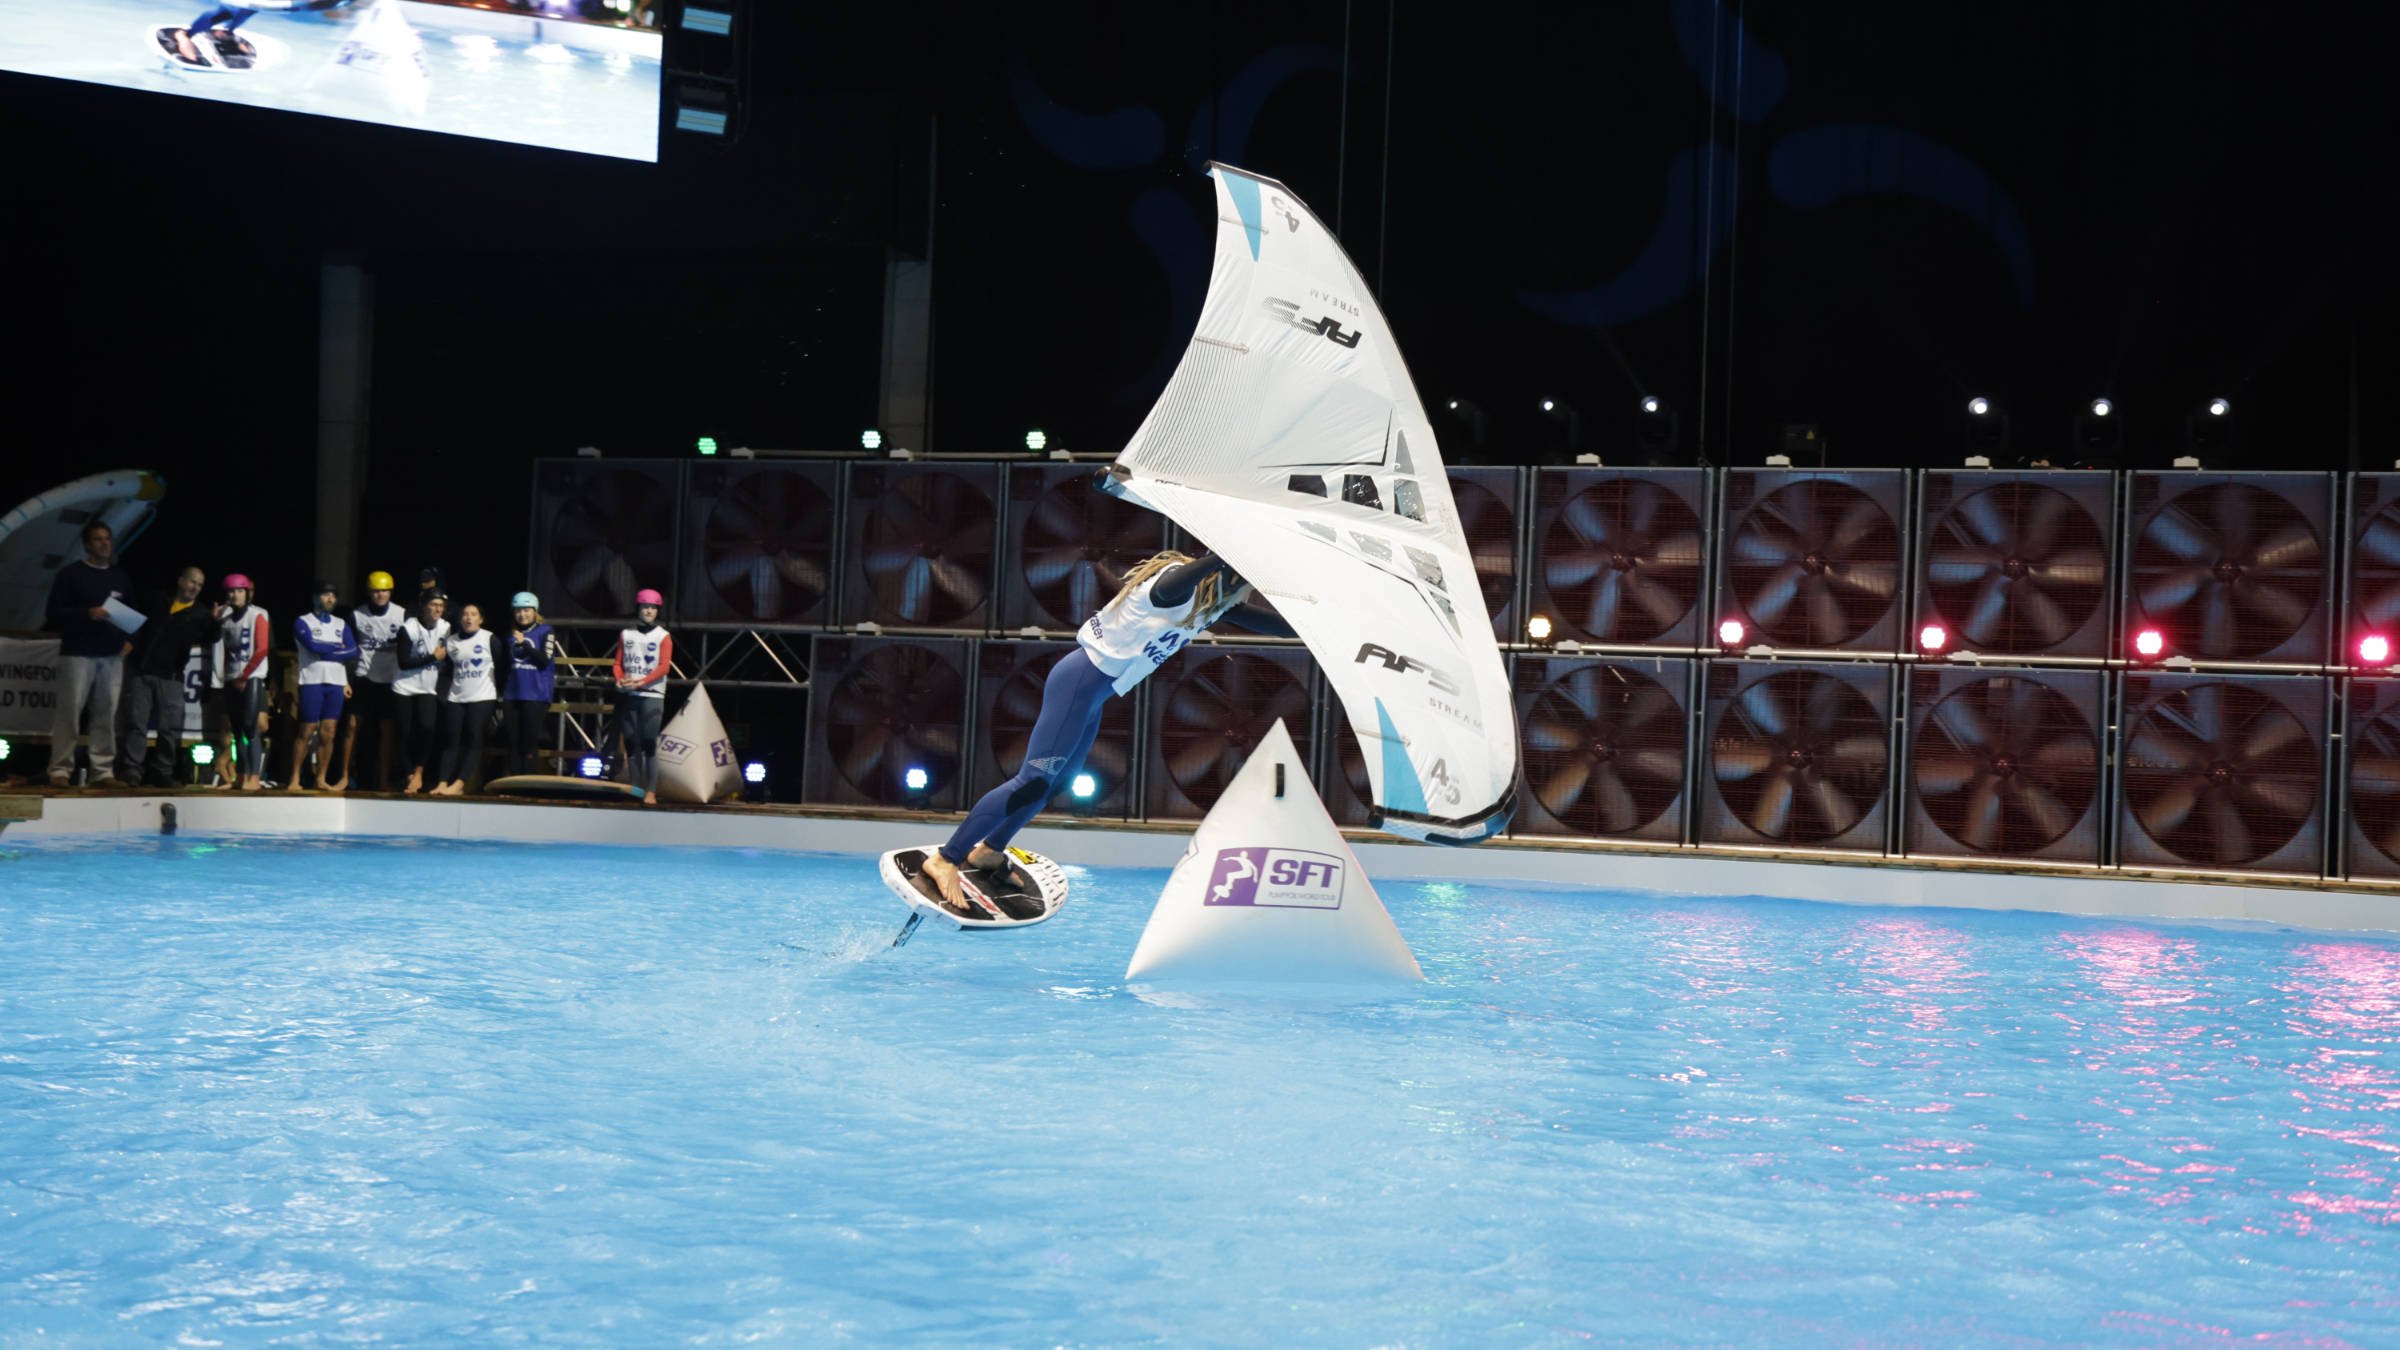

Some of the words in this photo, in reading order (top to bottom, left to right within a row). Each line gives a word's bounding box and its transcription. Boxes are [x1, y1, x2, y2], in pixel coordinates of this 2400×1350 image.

[1309, 287, 1360, 317] STREAM
[1263, 296, 1362, 349] AFS
[1354, 643, 1461, 697] AFS
[1429, 696, 1484, 730] STREAM
[661, 739, 692, 755] SFT
[1269, 858, 1340, 888] SFT
